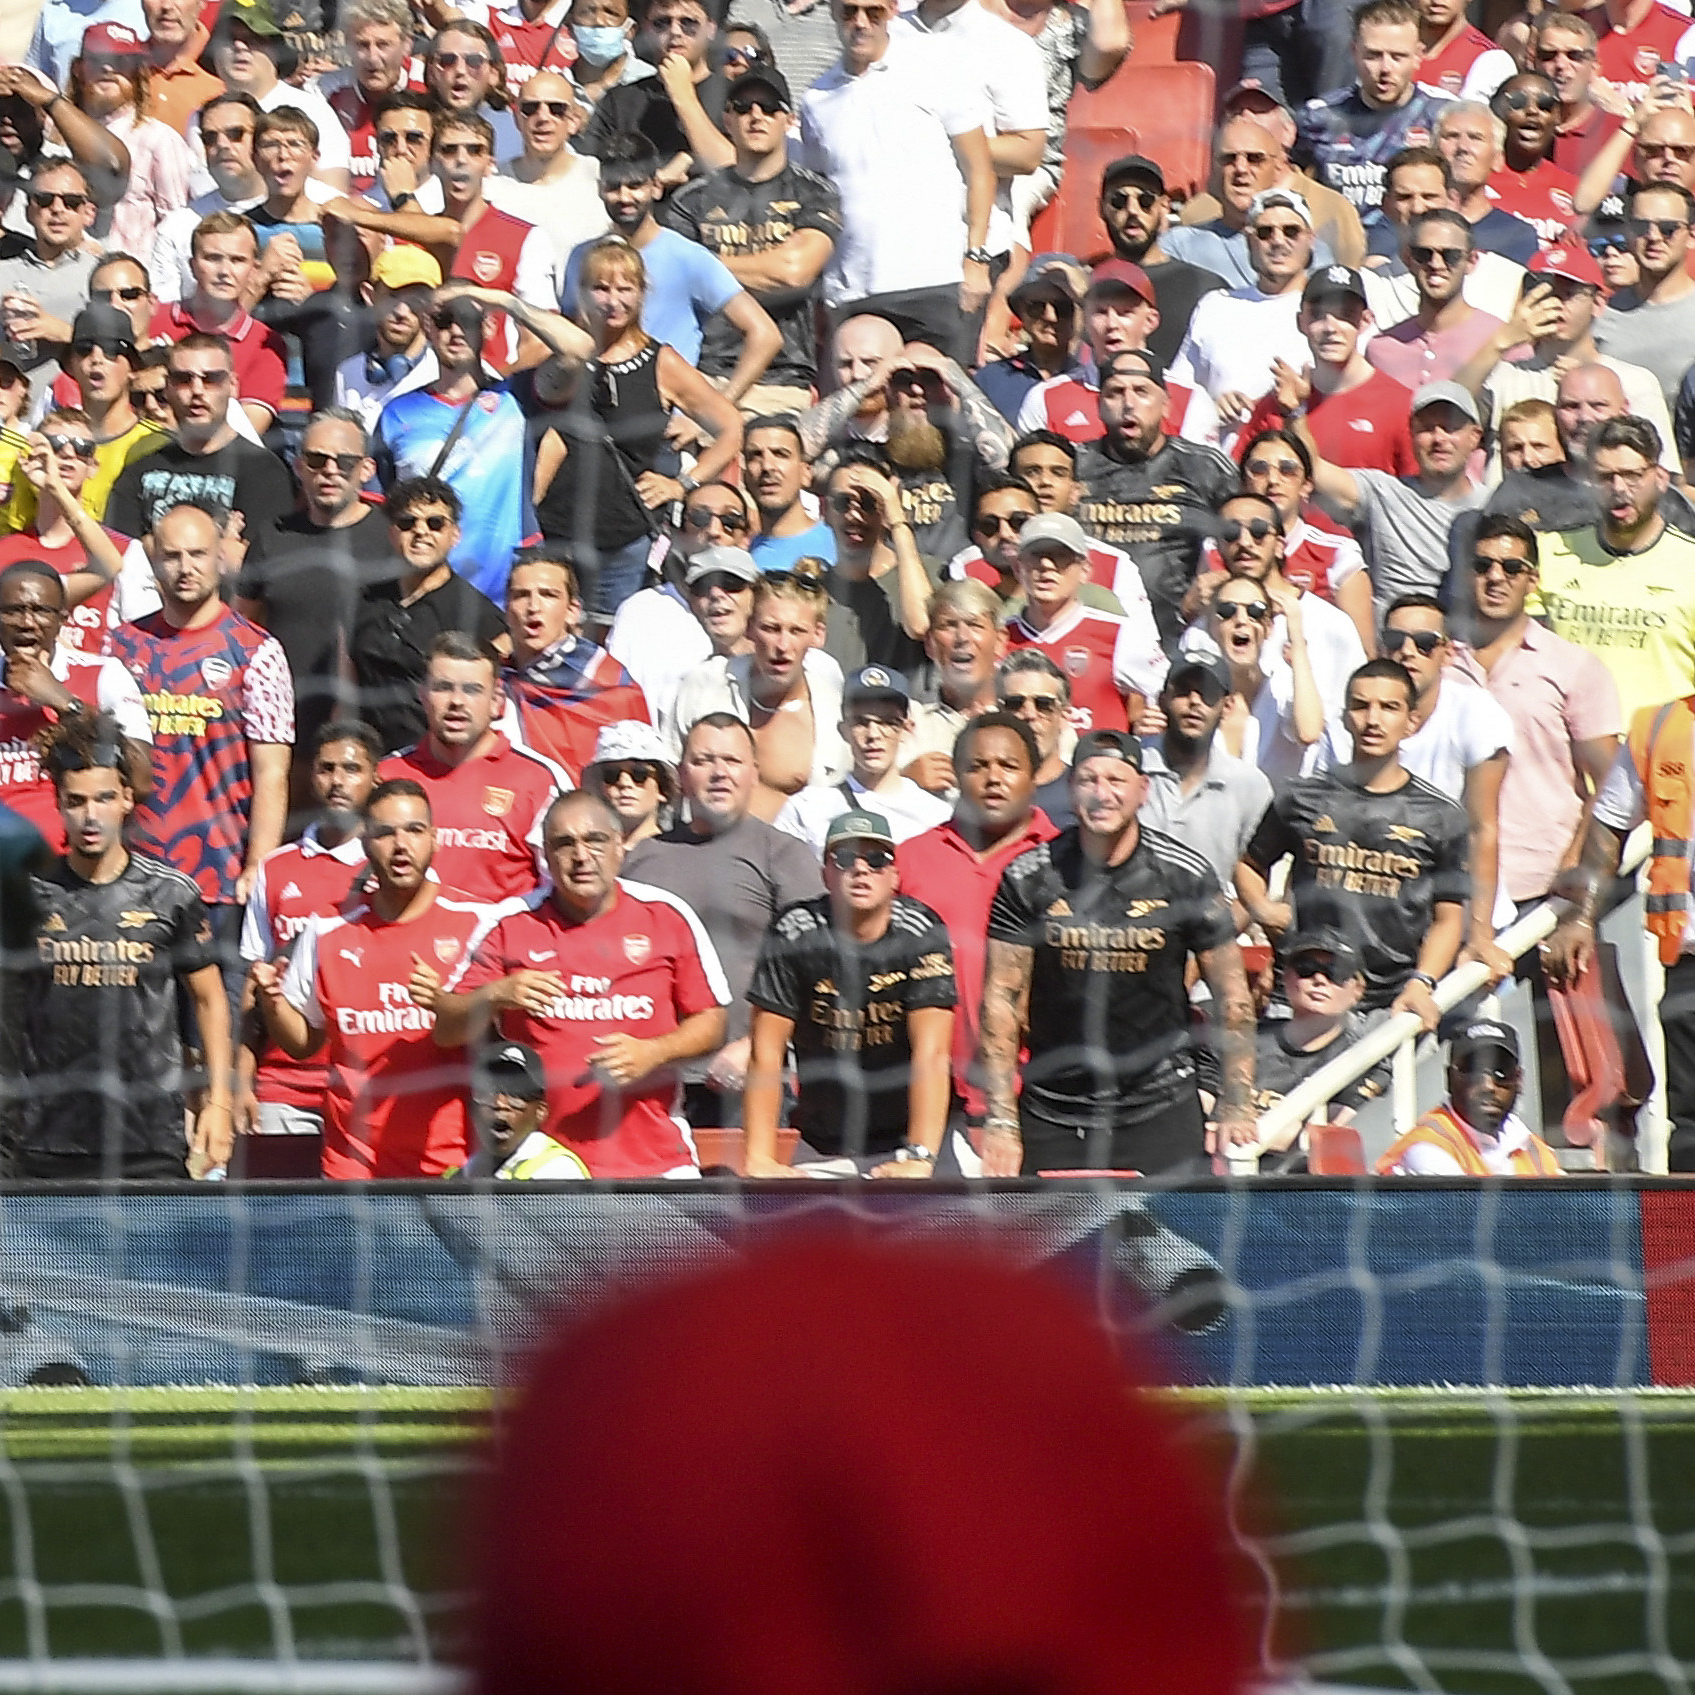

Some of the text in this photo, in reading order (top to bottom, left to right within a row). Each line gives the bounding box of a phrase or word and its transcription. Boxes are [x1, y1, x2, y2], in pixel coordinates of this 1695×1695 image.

[1326, 160, 1390, 187] Emir
[436, 826, 509, 854] mcast
[1305, 837, 1421, 880] Emirates
[38, 935, 155, 966] Emirates
[1044, 924, 1168, 951] Emirates
[336, 1006, 438, 1036] Emira
